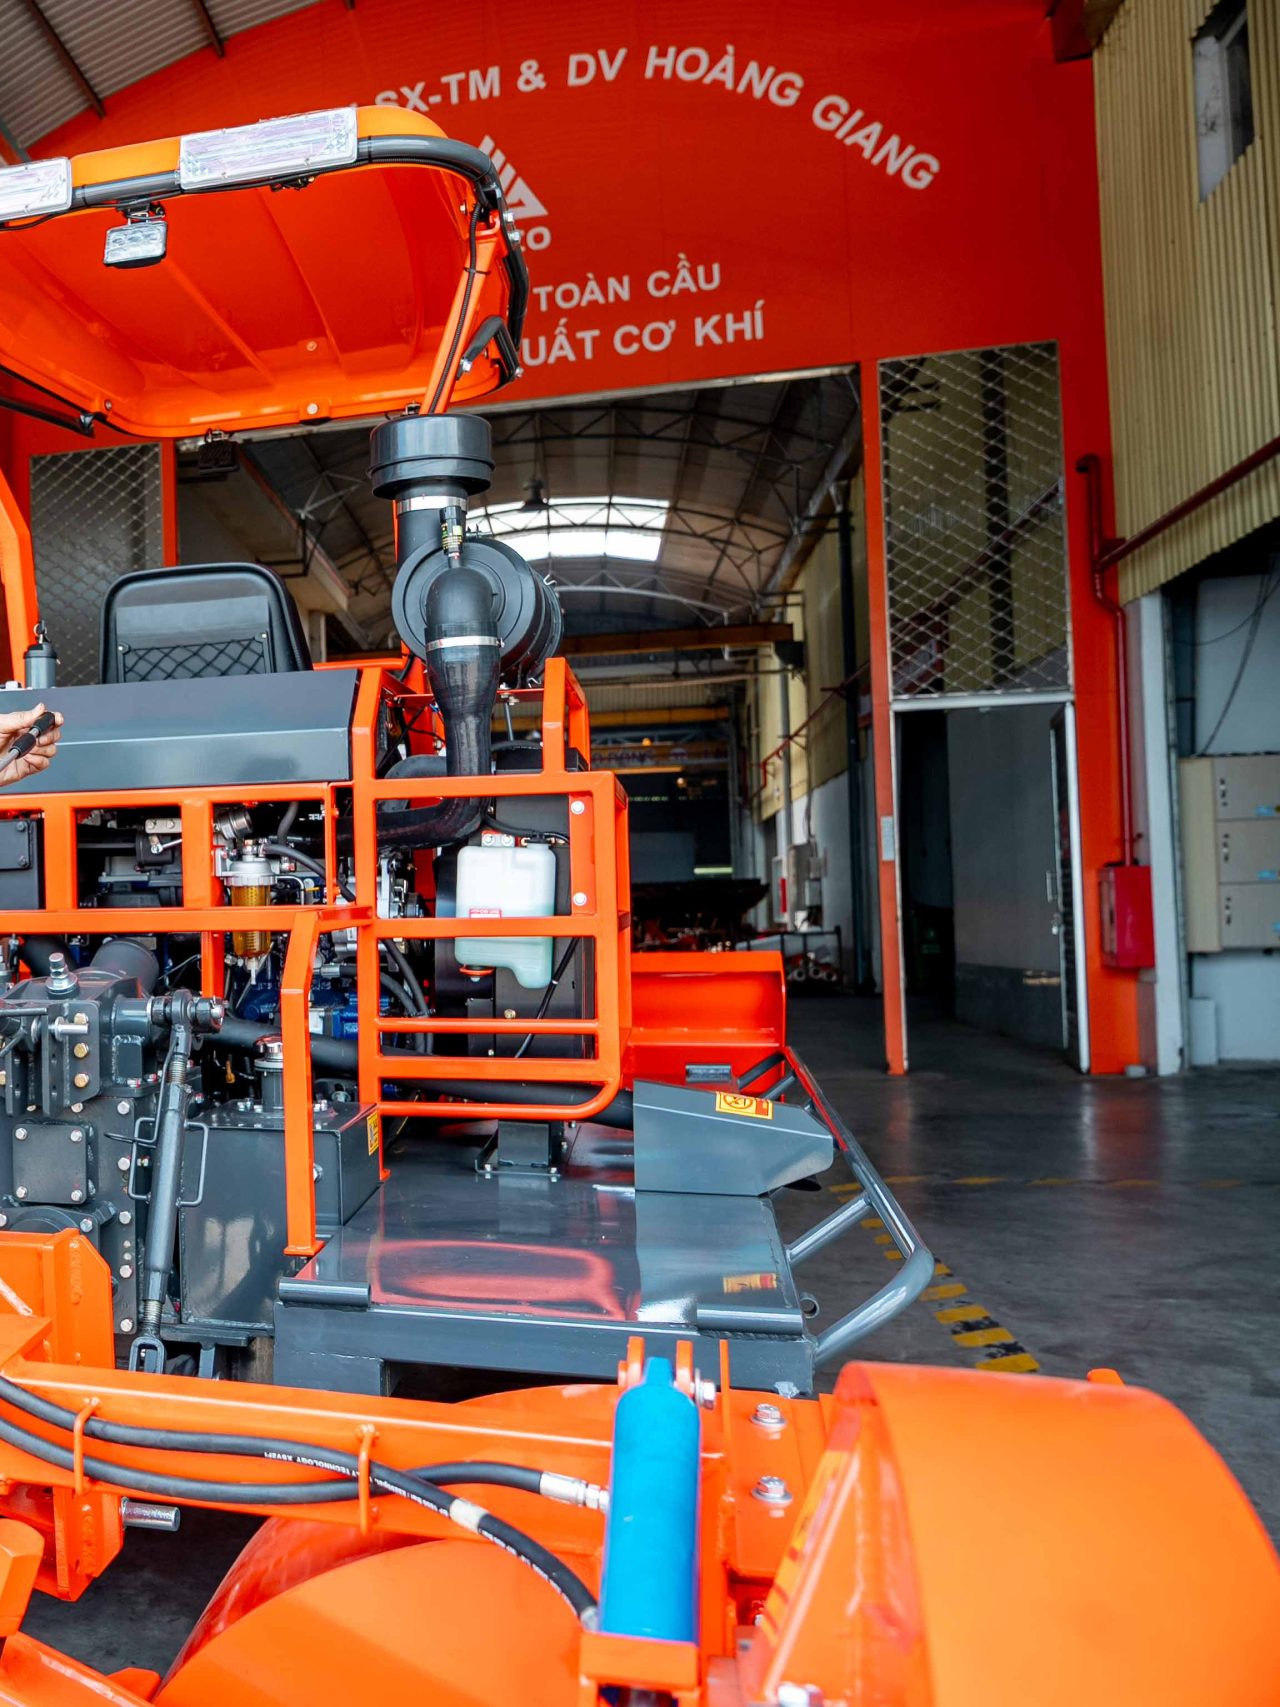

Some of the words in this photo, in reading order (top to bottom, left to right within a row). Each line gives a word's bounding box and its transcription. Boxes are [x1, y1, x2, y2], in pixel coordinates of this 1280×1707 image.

[517, 59, 547, 93] &
[567, 48, 628, 87] DV
[645, 44, 805, 108] HOÀNG
[810, 93, 942, 191] GIANG
[532, 271, 632, 313] TOÀN
[646, 252, 722, 297] CẦU
[521, 321, 603, 368] UẤT
[613, 318, 677, 356] CƠ
[694, 299, 766, 348] KHÍ
